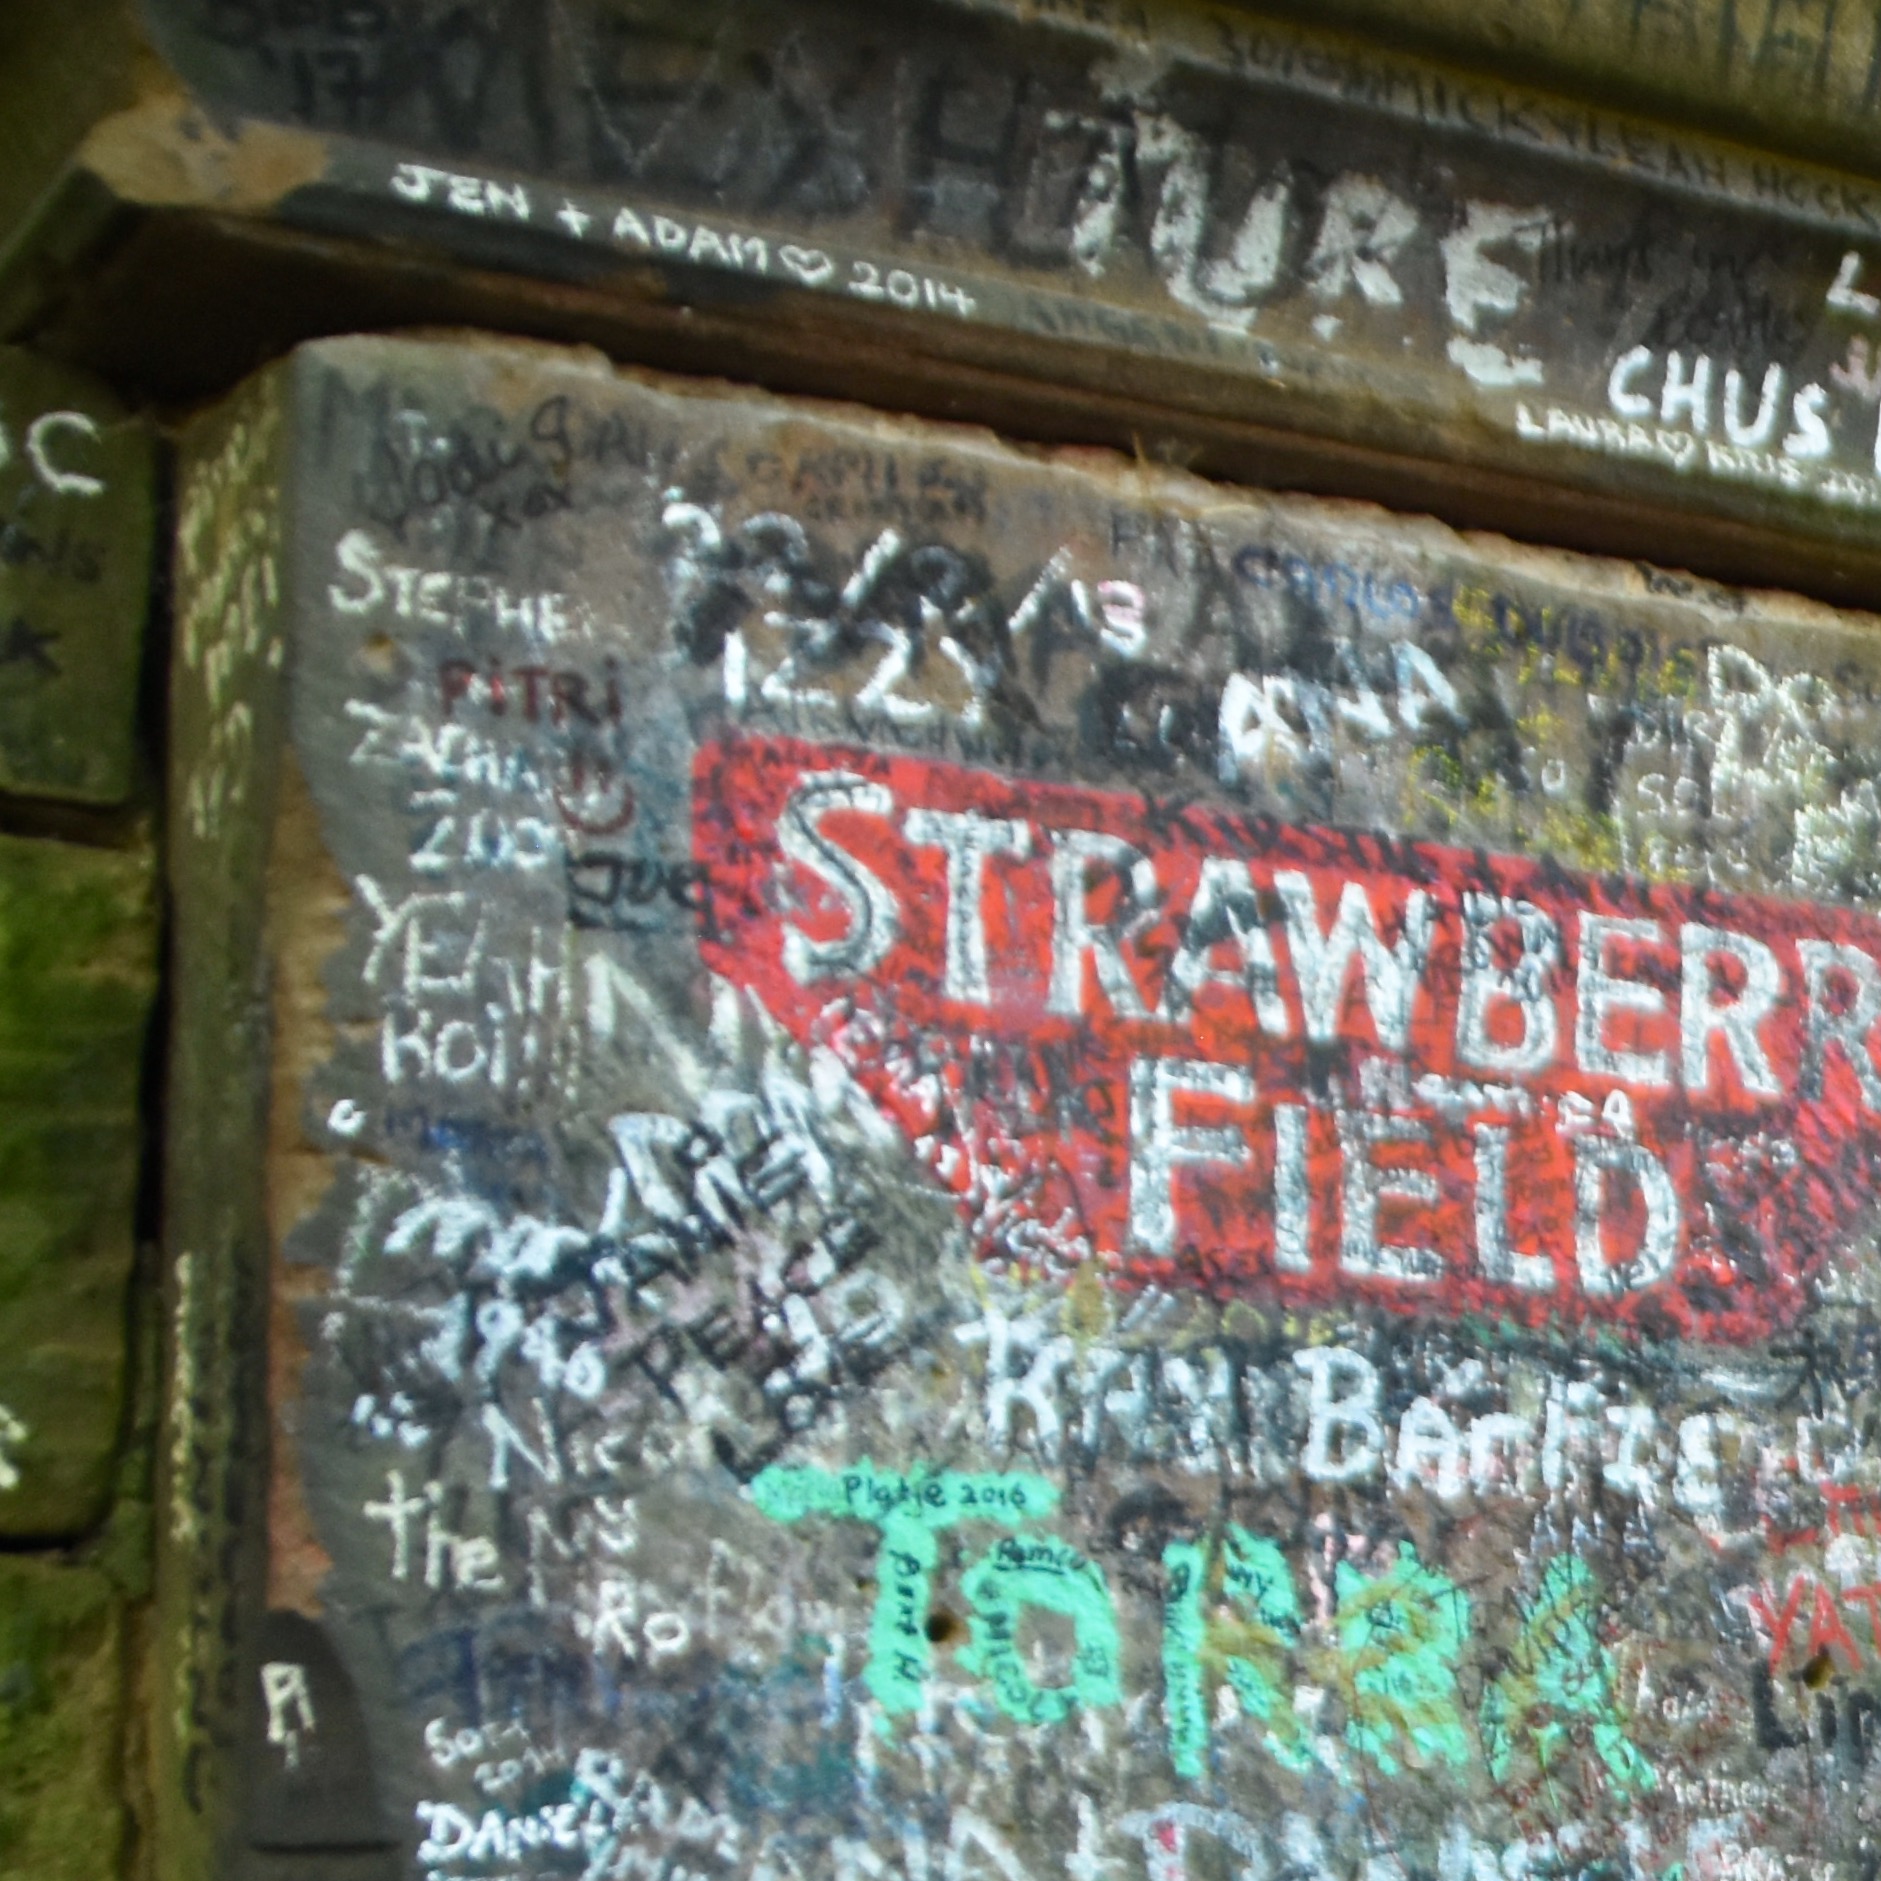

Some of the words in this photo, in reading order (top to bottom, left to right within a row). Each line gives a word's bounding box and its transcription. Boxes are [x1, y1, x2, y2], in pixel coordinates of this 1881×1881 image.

[391, 162, 530, 219] JEN
[612, 204, 770, 278] ADAM
[848, 260, 978, 315] 2014
[1607, 344, 1833, 459] CHUS
[1126, 1056, 1682, 1294] FIELD
